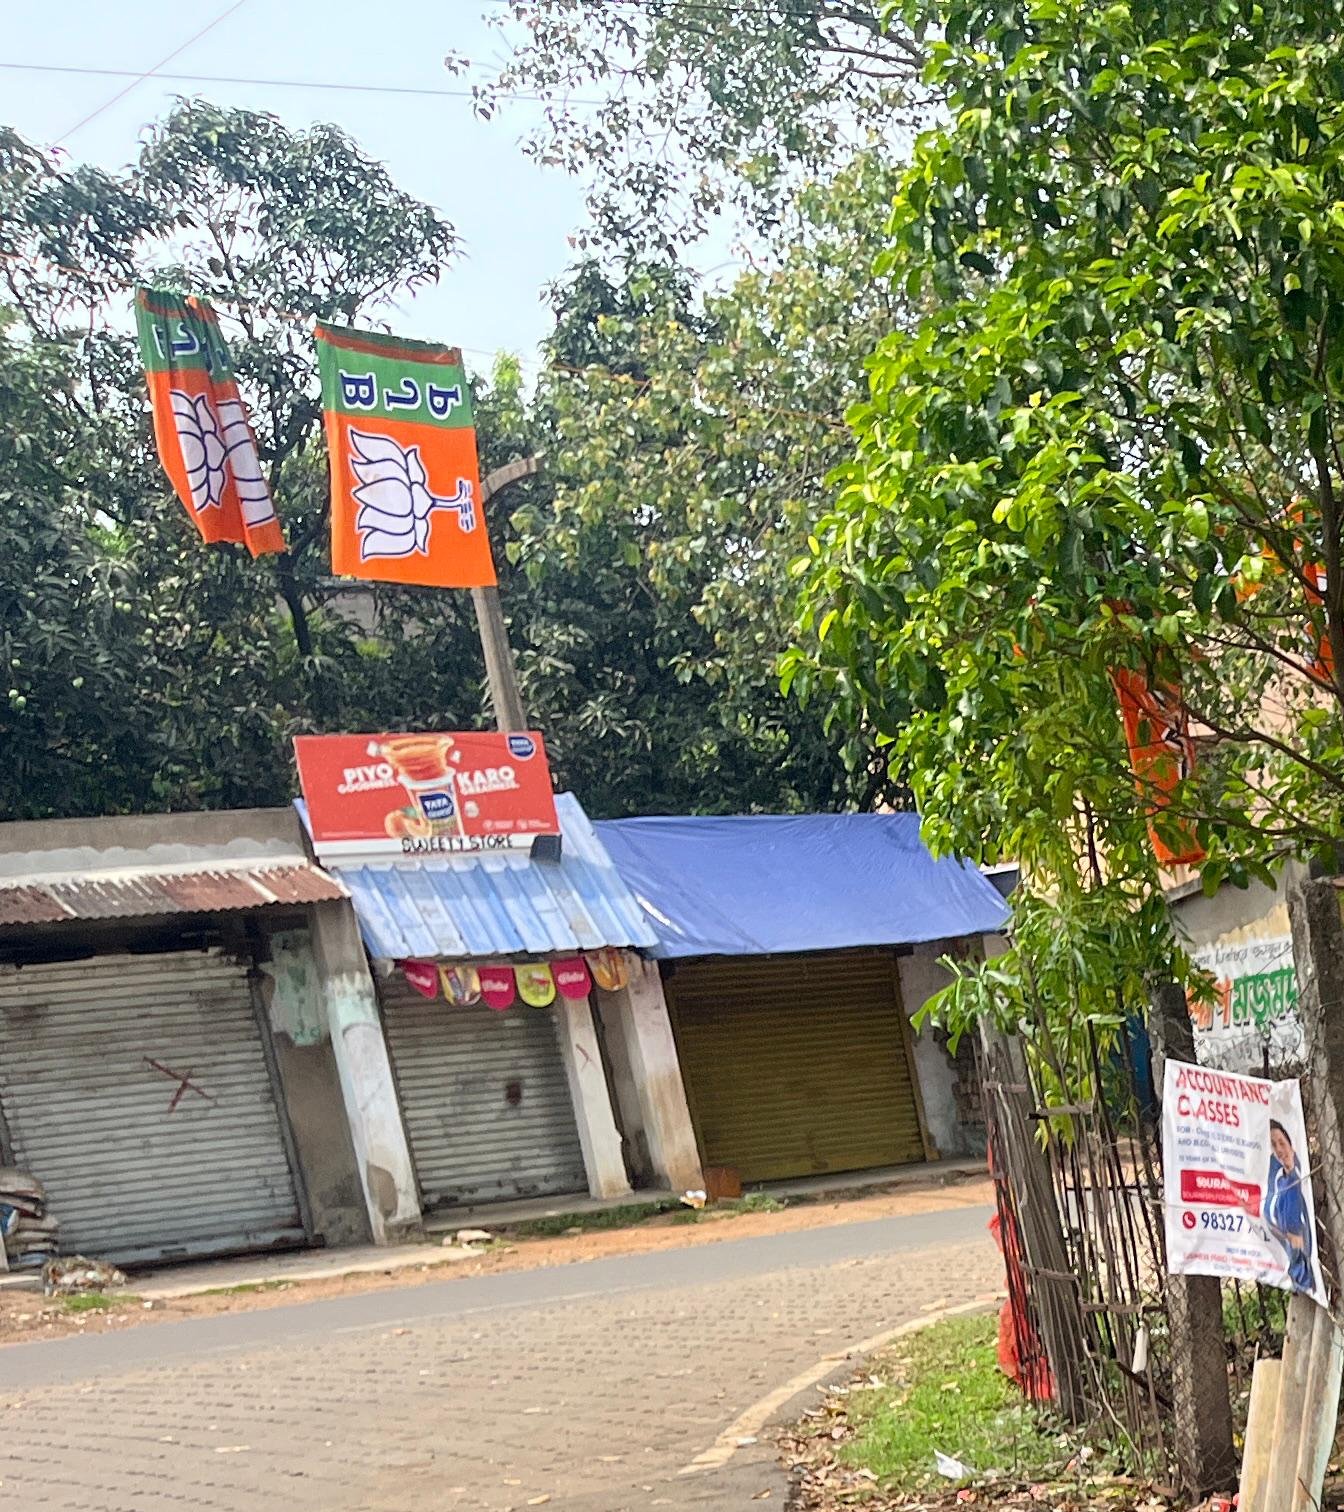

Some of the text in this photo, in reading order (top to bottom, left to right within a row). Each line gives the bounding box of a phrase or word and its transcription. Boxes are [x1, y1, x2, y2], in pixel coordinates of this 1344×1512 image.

[343, 763, 393, 785] PIYO
[456, 765, 515, 791] KARO
[401, 835, 513, 853] SWEETY STORE
[1177, 1094, 1240, 1128] CASSES
[1201, 1211, 1244, 1233] 98327
